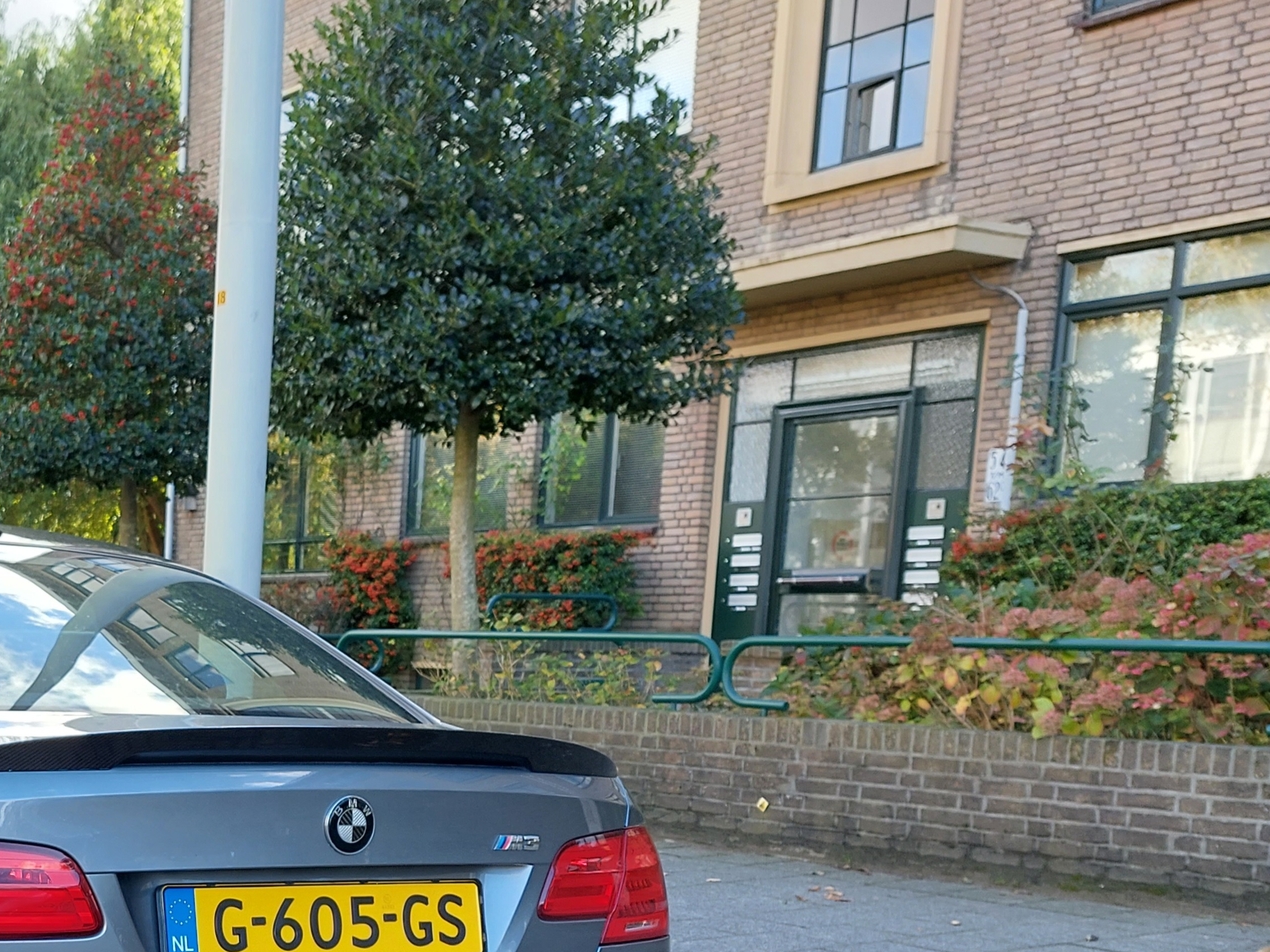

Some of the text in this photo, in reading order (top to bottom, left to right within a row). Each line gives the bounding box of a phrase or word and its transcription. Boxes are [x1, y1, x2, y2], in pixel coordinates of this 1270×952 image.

[333, 797, 372, 817] BMW
[506, 834, 540, 851] M3
[214, 893, 467, 952] G-605-GS
[172, 935, 194, 952] NL
